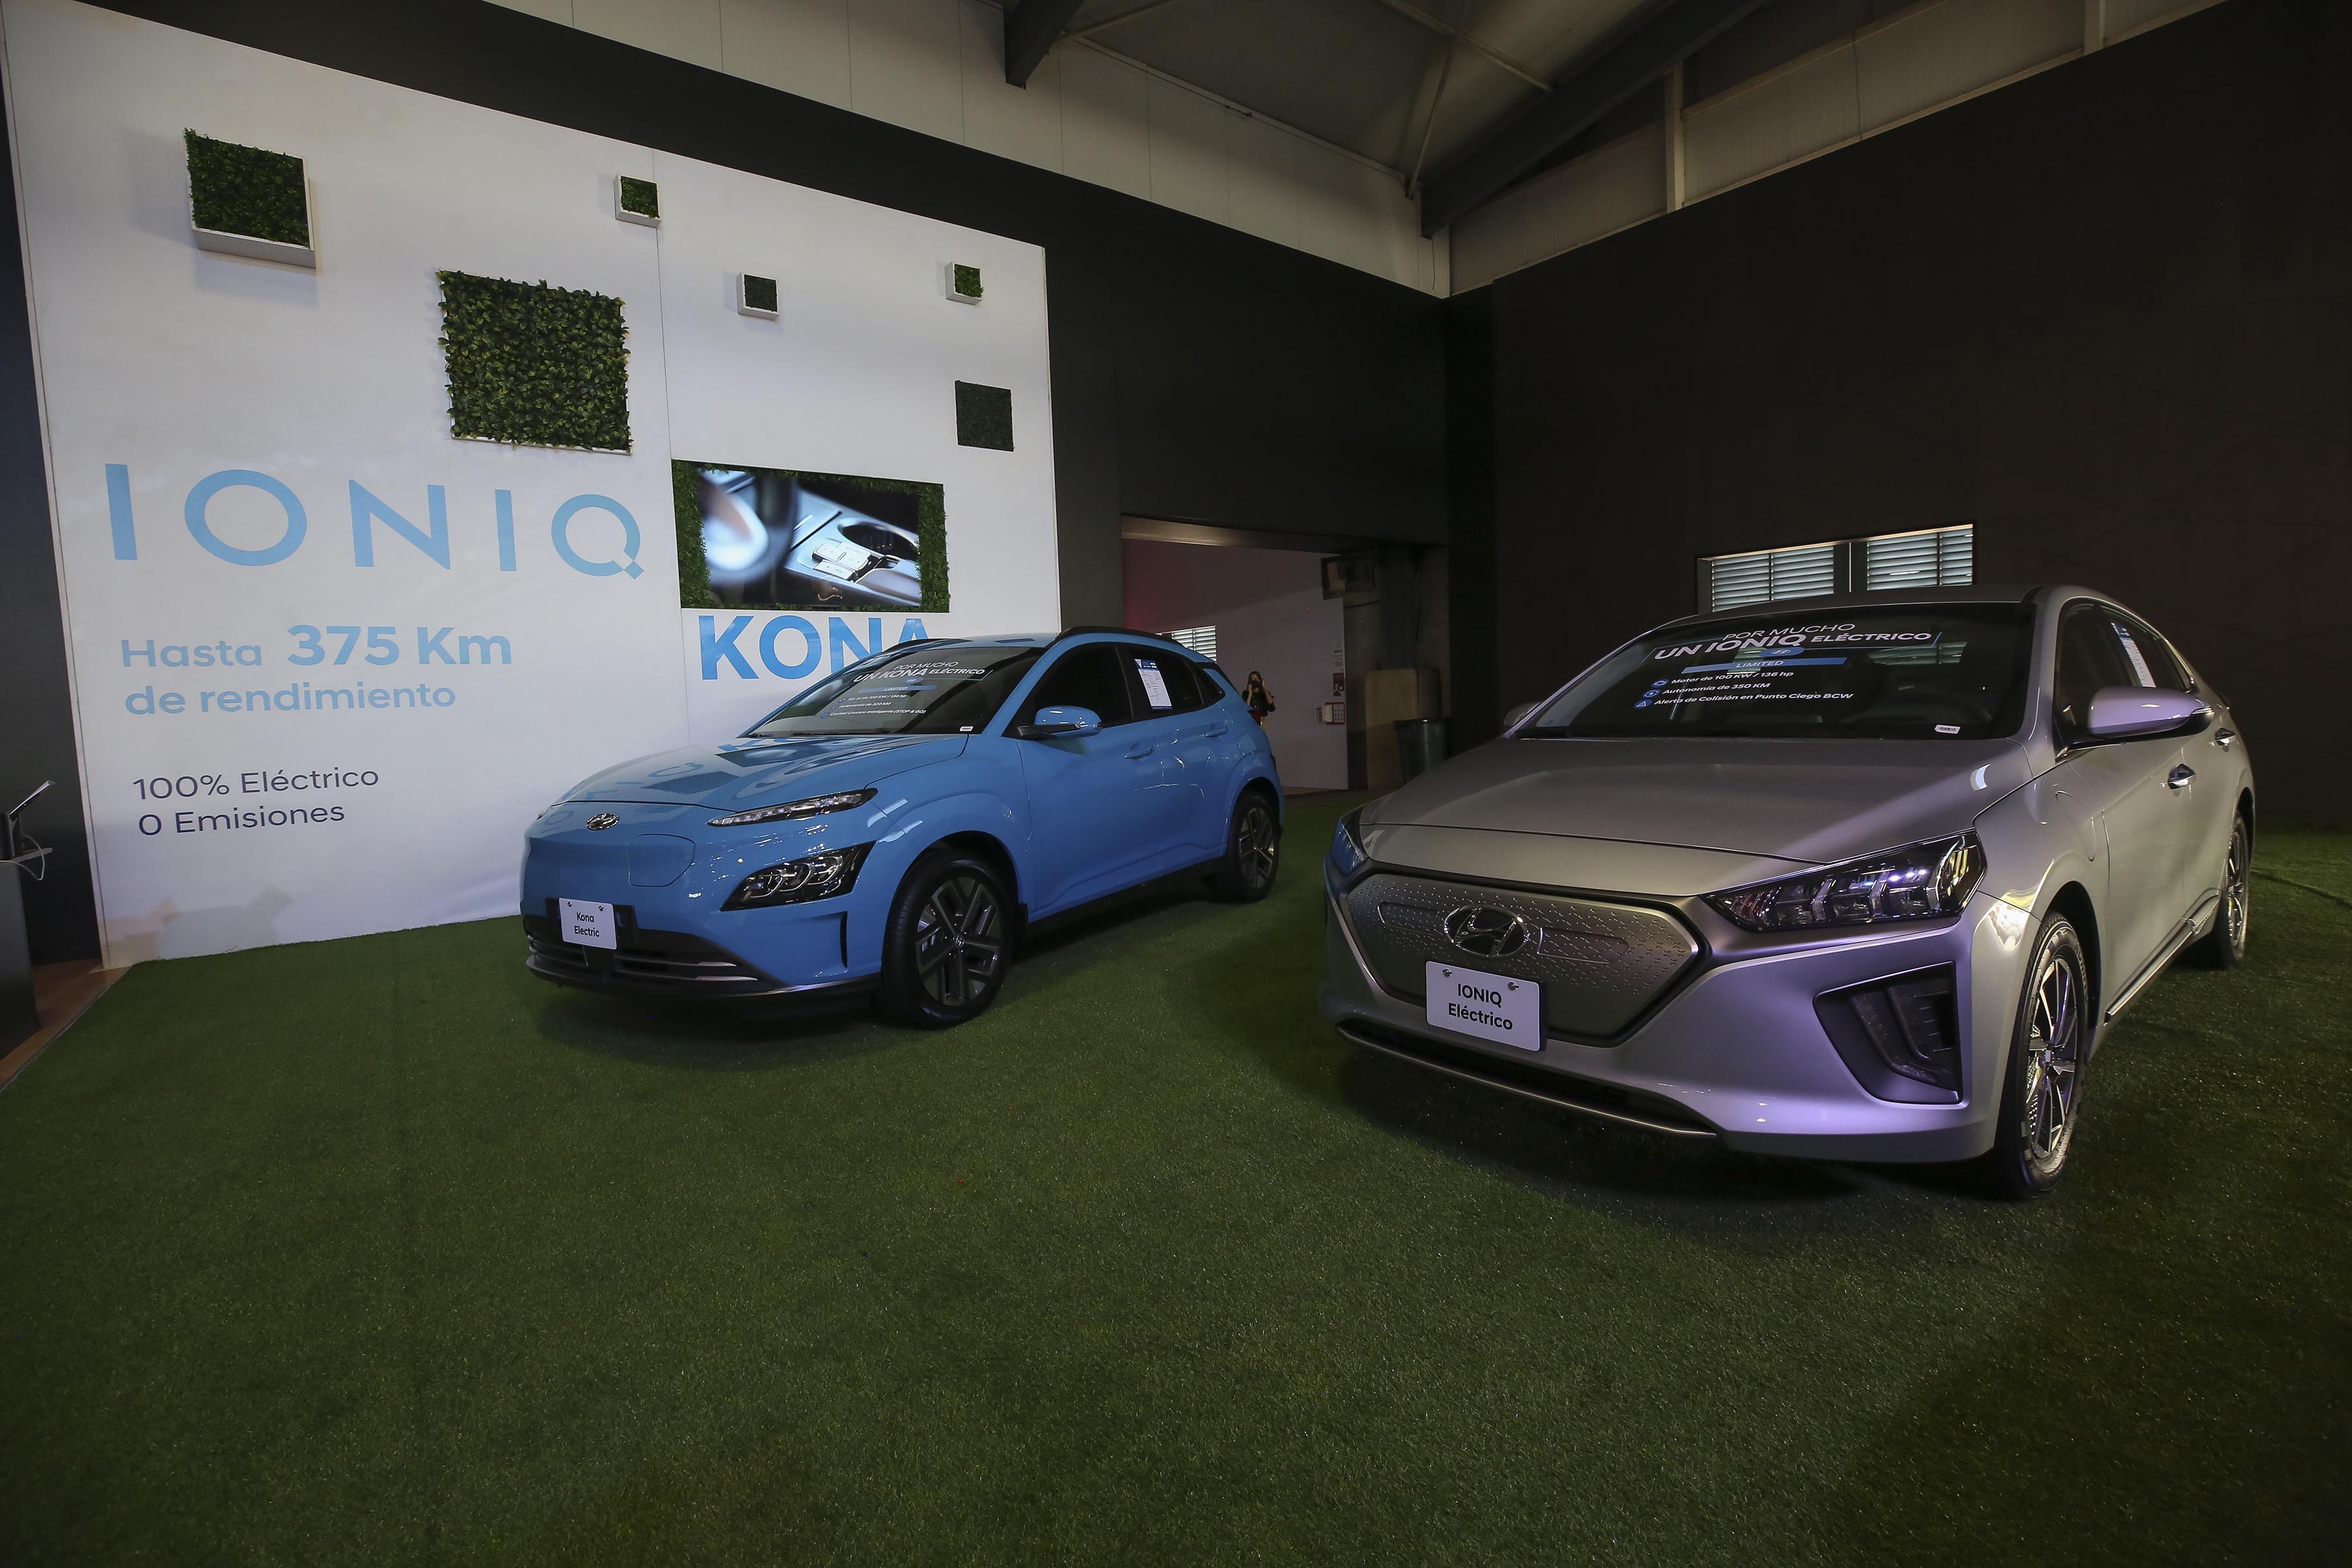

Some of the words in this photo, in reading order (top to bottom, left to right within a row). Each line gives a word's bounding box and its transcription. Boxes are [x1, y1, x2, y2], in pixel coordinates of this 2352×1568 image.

[105, 463, 645, 580] IONIQ
[1654, 644, 1703, 659] UN
[1704, 634, 1806, 653] IONIQ
[1810, 632, 1932, 642] ELÉCTRICO
[1722, 630, 1765, 641] POR
[1769, 623, 1855, 636] MUCHO
[122, 638, 262, 668] Hasta
[287, 624, 400, 666] 375
[417, 627, 512, 666] Km
[853, 672, 880, 683] UN
[879, 668, 928, 679] KONA
[125, 685, 186, 715] de
[201, 681, 456, 713] rendimiento
[1662, 685, 1716, 694] Autonomía
[133, 773, 230, 800] 100%
[241, 767, 380, 794] Eléctrico
[176, 802, 346, 834] Emisiones
[576, 912, 595, 923] Kona
[574, 925, 600, 938] Electric
[1458, 983, 1502, 1008] IONIQ
[1448, 1002, 1513, 1030] Eléctrico
